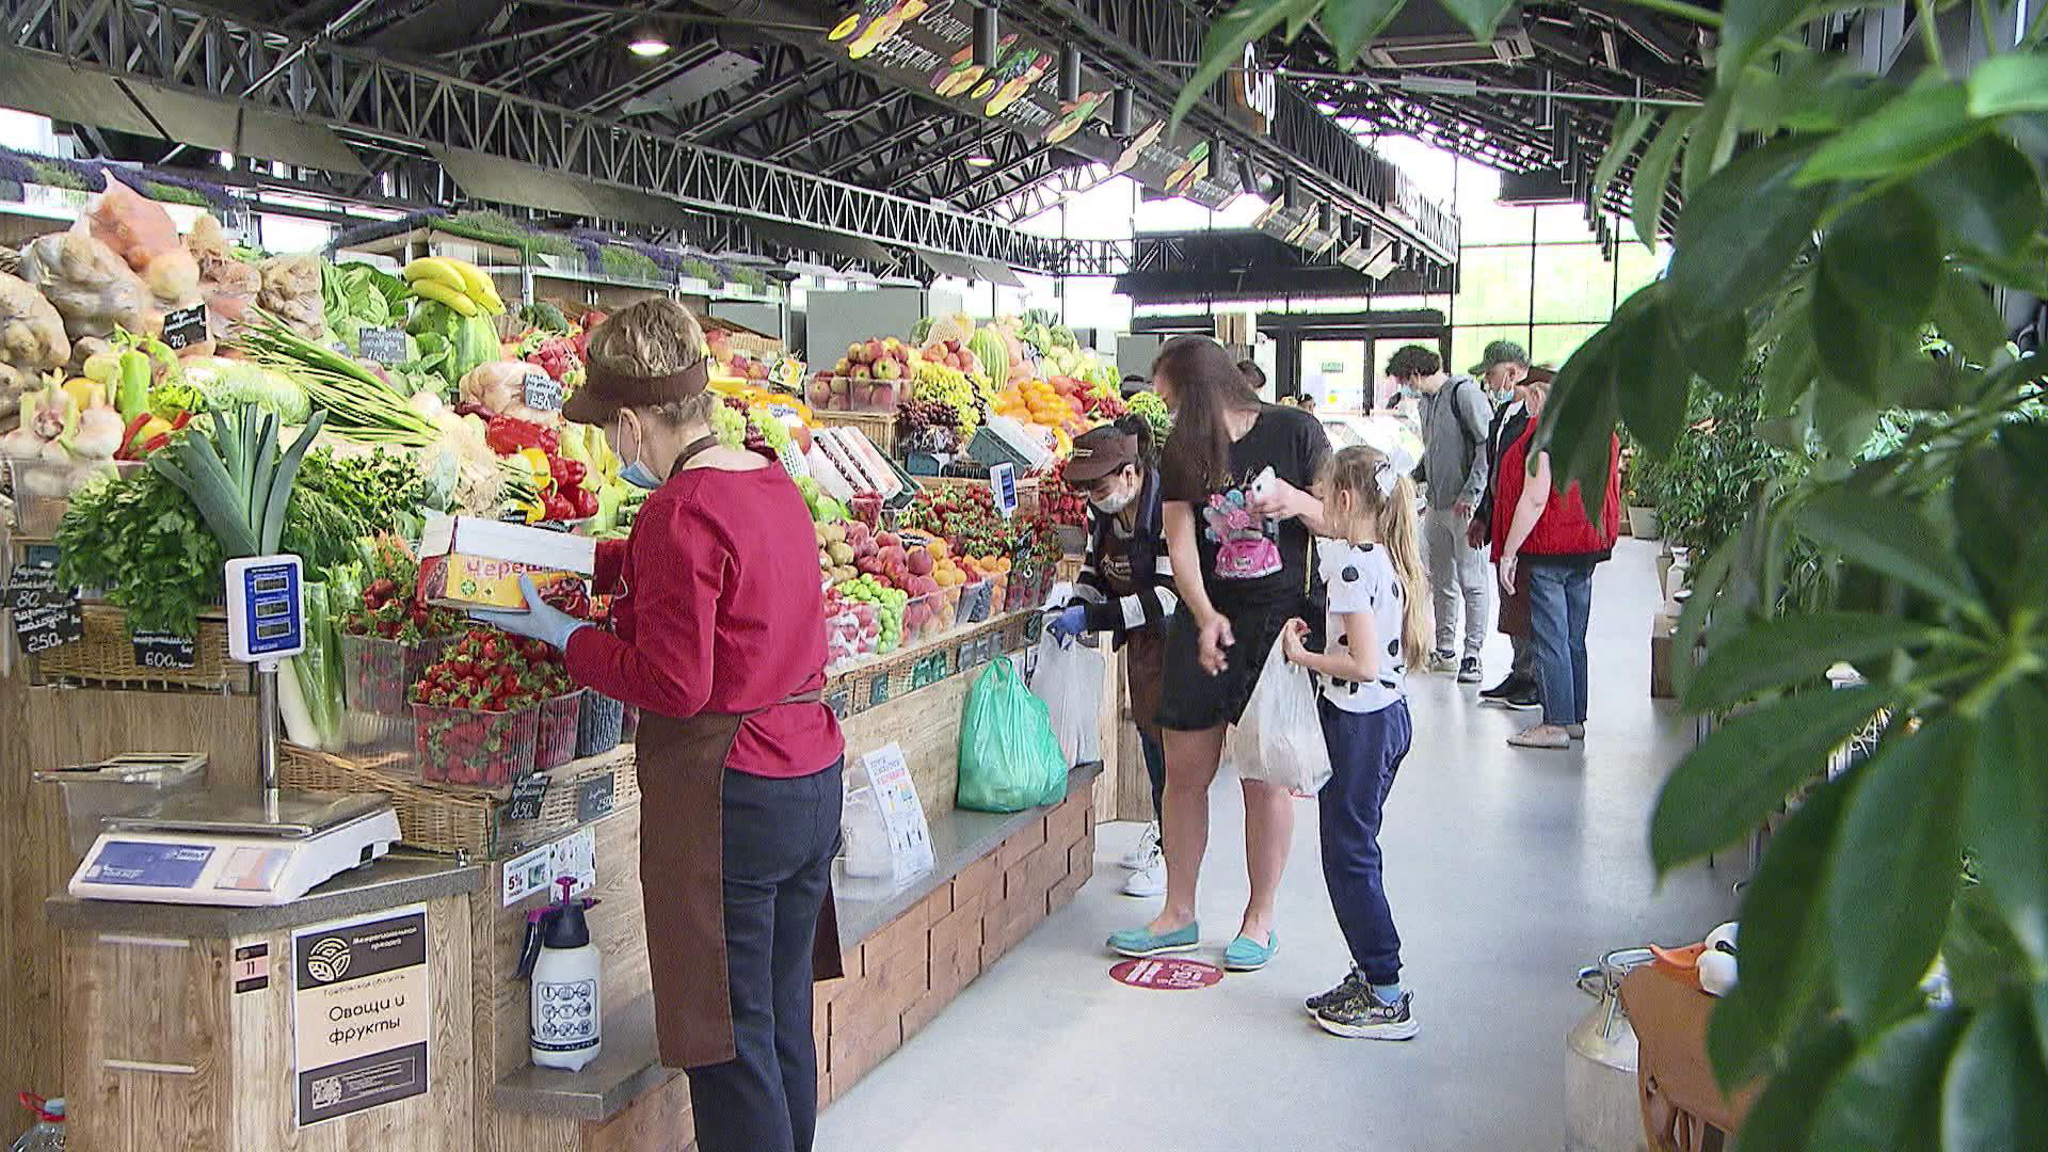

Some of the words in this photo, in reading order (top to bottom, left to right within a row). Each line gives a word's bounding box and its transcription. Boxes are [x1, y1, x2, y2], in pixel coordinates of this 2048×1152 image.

[1244, 42, 1276, 135] Сыр
[246, 961, 255, 975] 11
[329, 999, 390, 1021] Овощи
[395, 995, 405, 1007] и
[329, 1017, 400, 1045] фрукты
